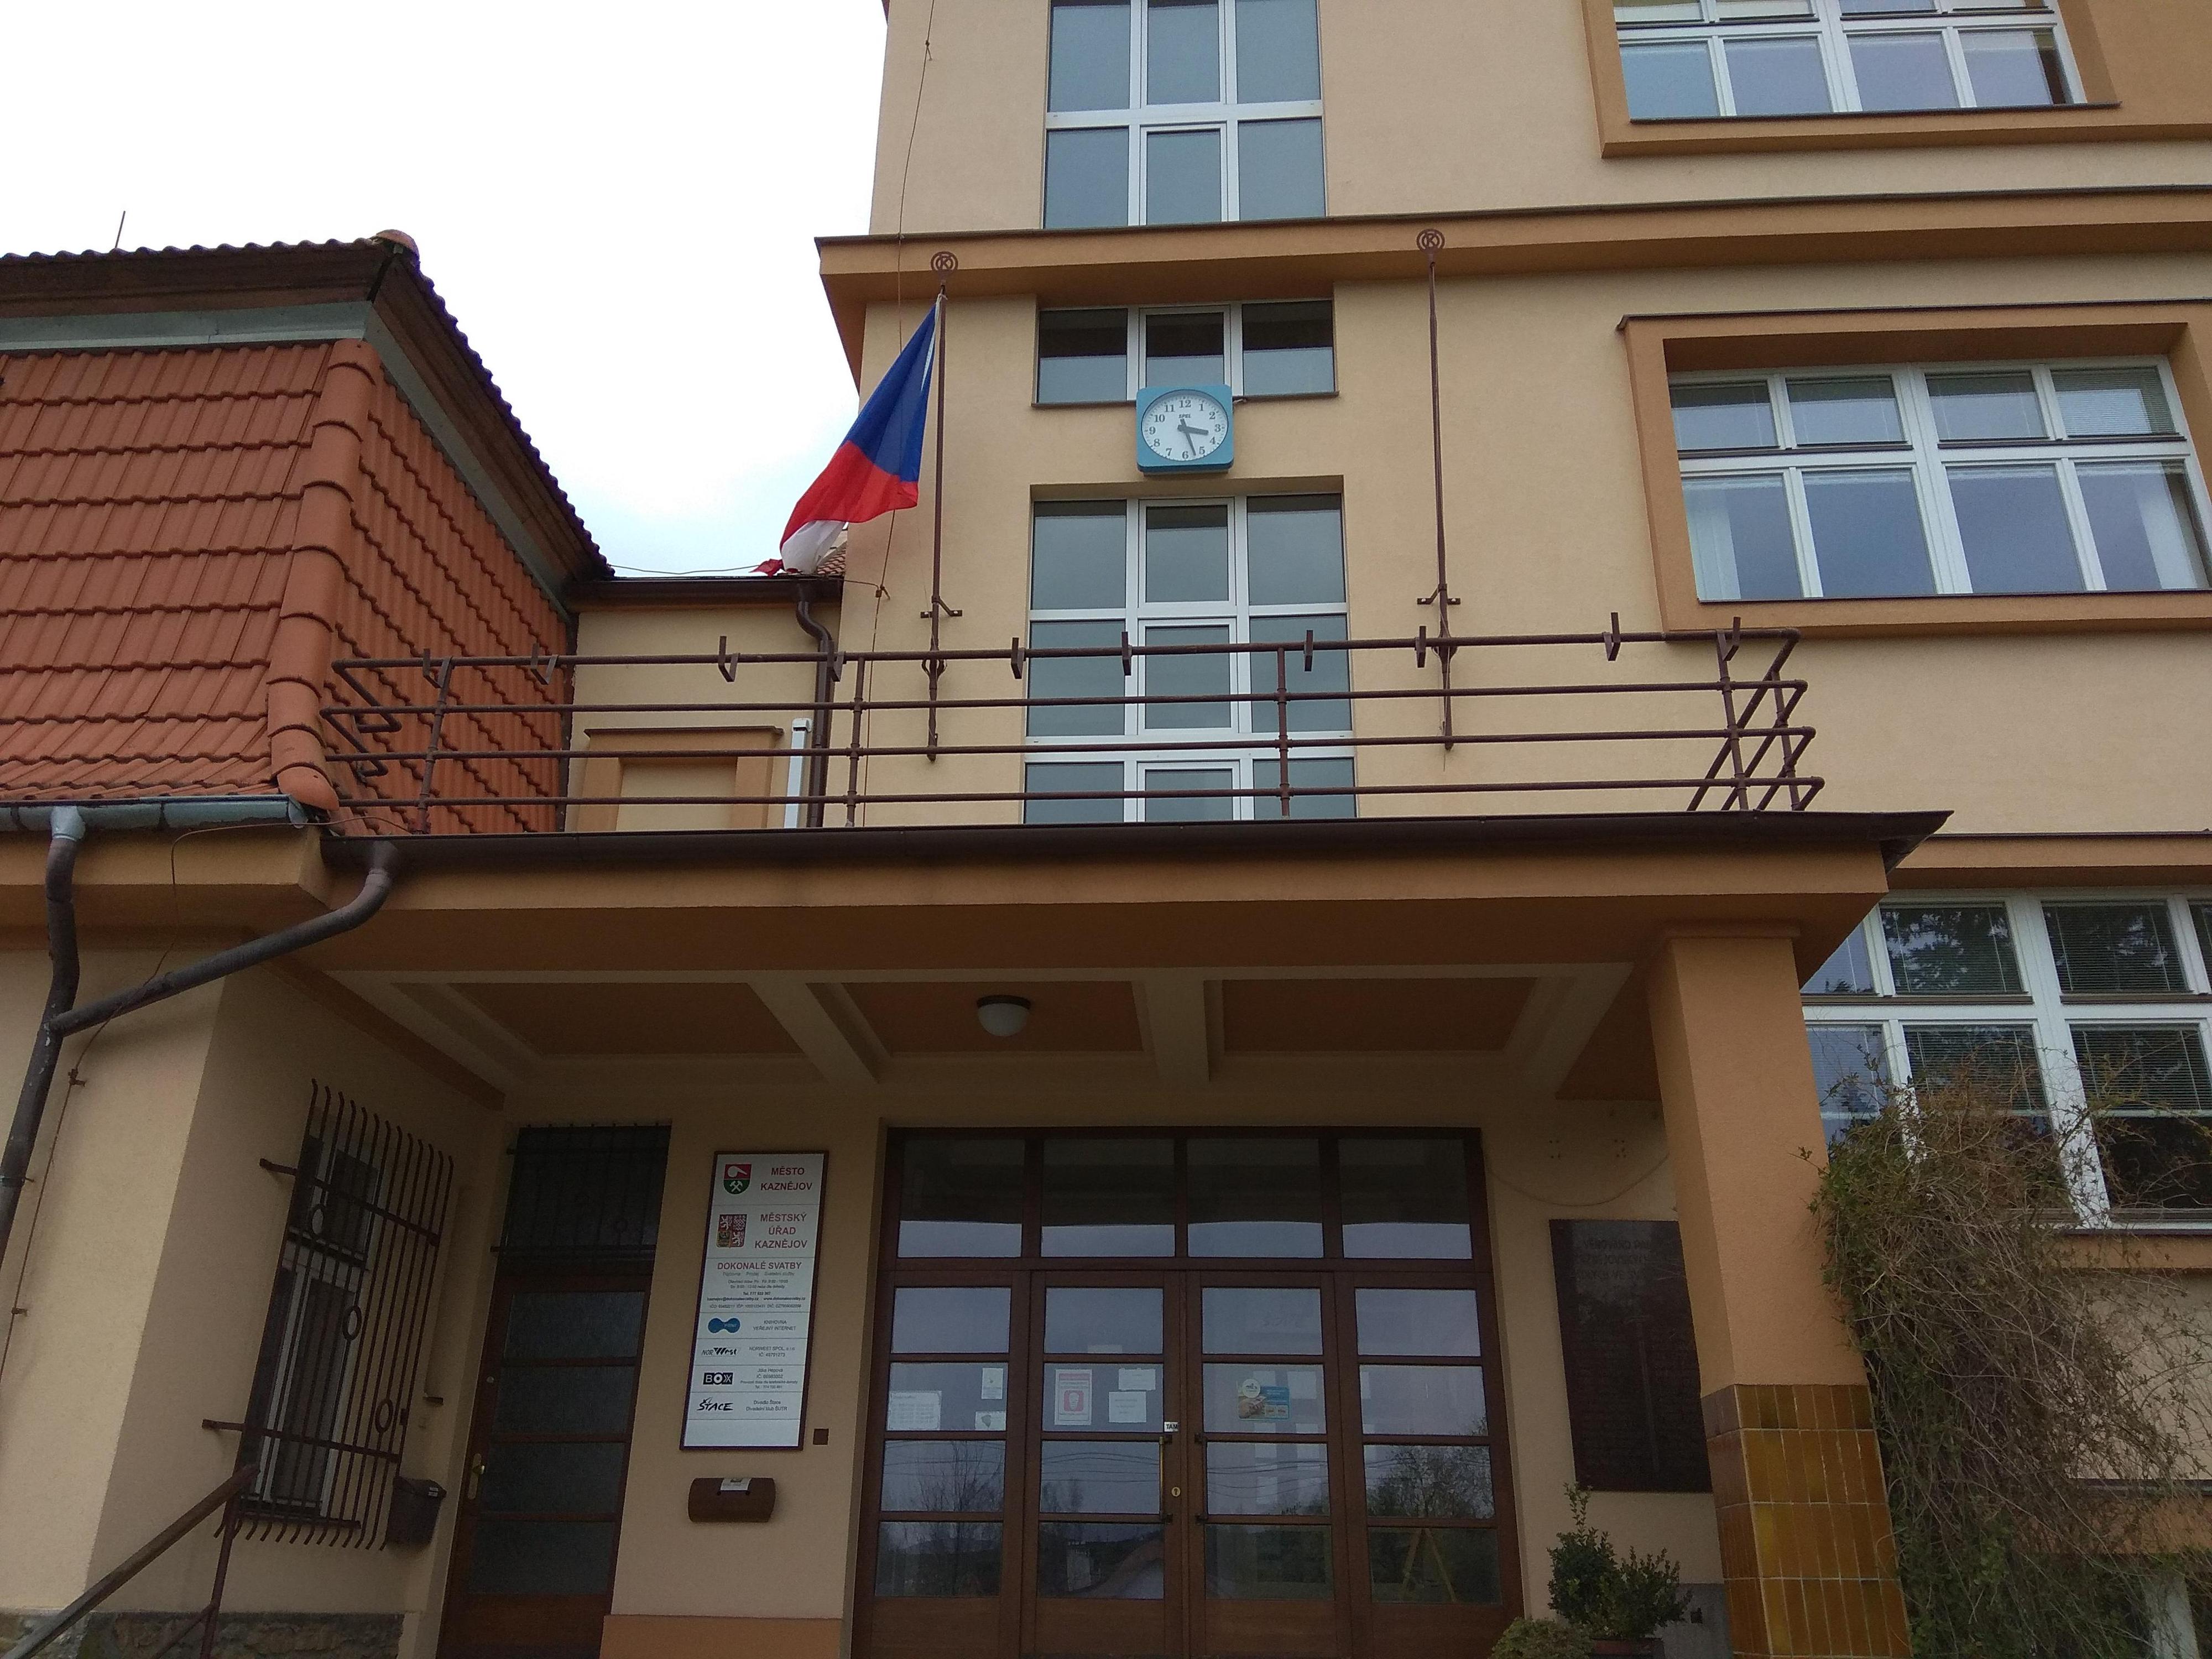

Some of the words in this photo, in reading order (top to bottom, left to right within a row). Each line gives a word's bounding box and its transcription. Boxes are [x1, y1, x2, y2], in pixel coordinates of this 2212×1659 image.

[1179, 400, 1191, 408] 12
[1154, 414, 1165, 422] 10
[1209, 411, 1216, 420] 2
[1149, 426, 1156, 435] 9
[1154, 439, 1160, 447] 8
[1166, 448, 1172, 456] 7
[1182, 451, 1189, 459] 6
[1199, 446, 1206, 455] 5
[771, 1166, 805, 1175] MĚSTO
[760, 1181, 813, 1191] KAZNĚJOV
[760, 1212, 807, 1222] MĚSTSKÝ
[768, 1225, 796, 1235] ÚŘAD
[754, 1237, 807, 1248] KAZNĚJOV
[717, 1261, 765, 1270] DOKONALÉ
